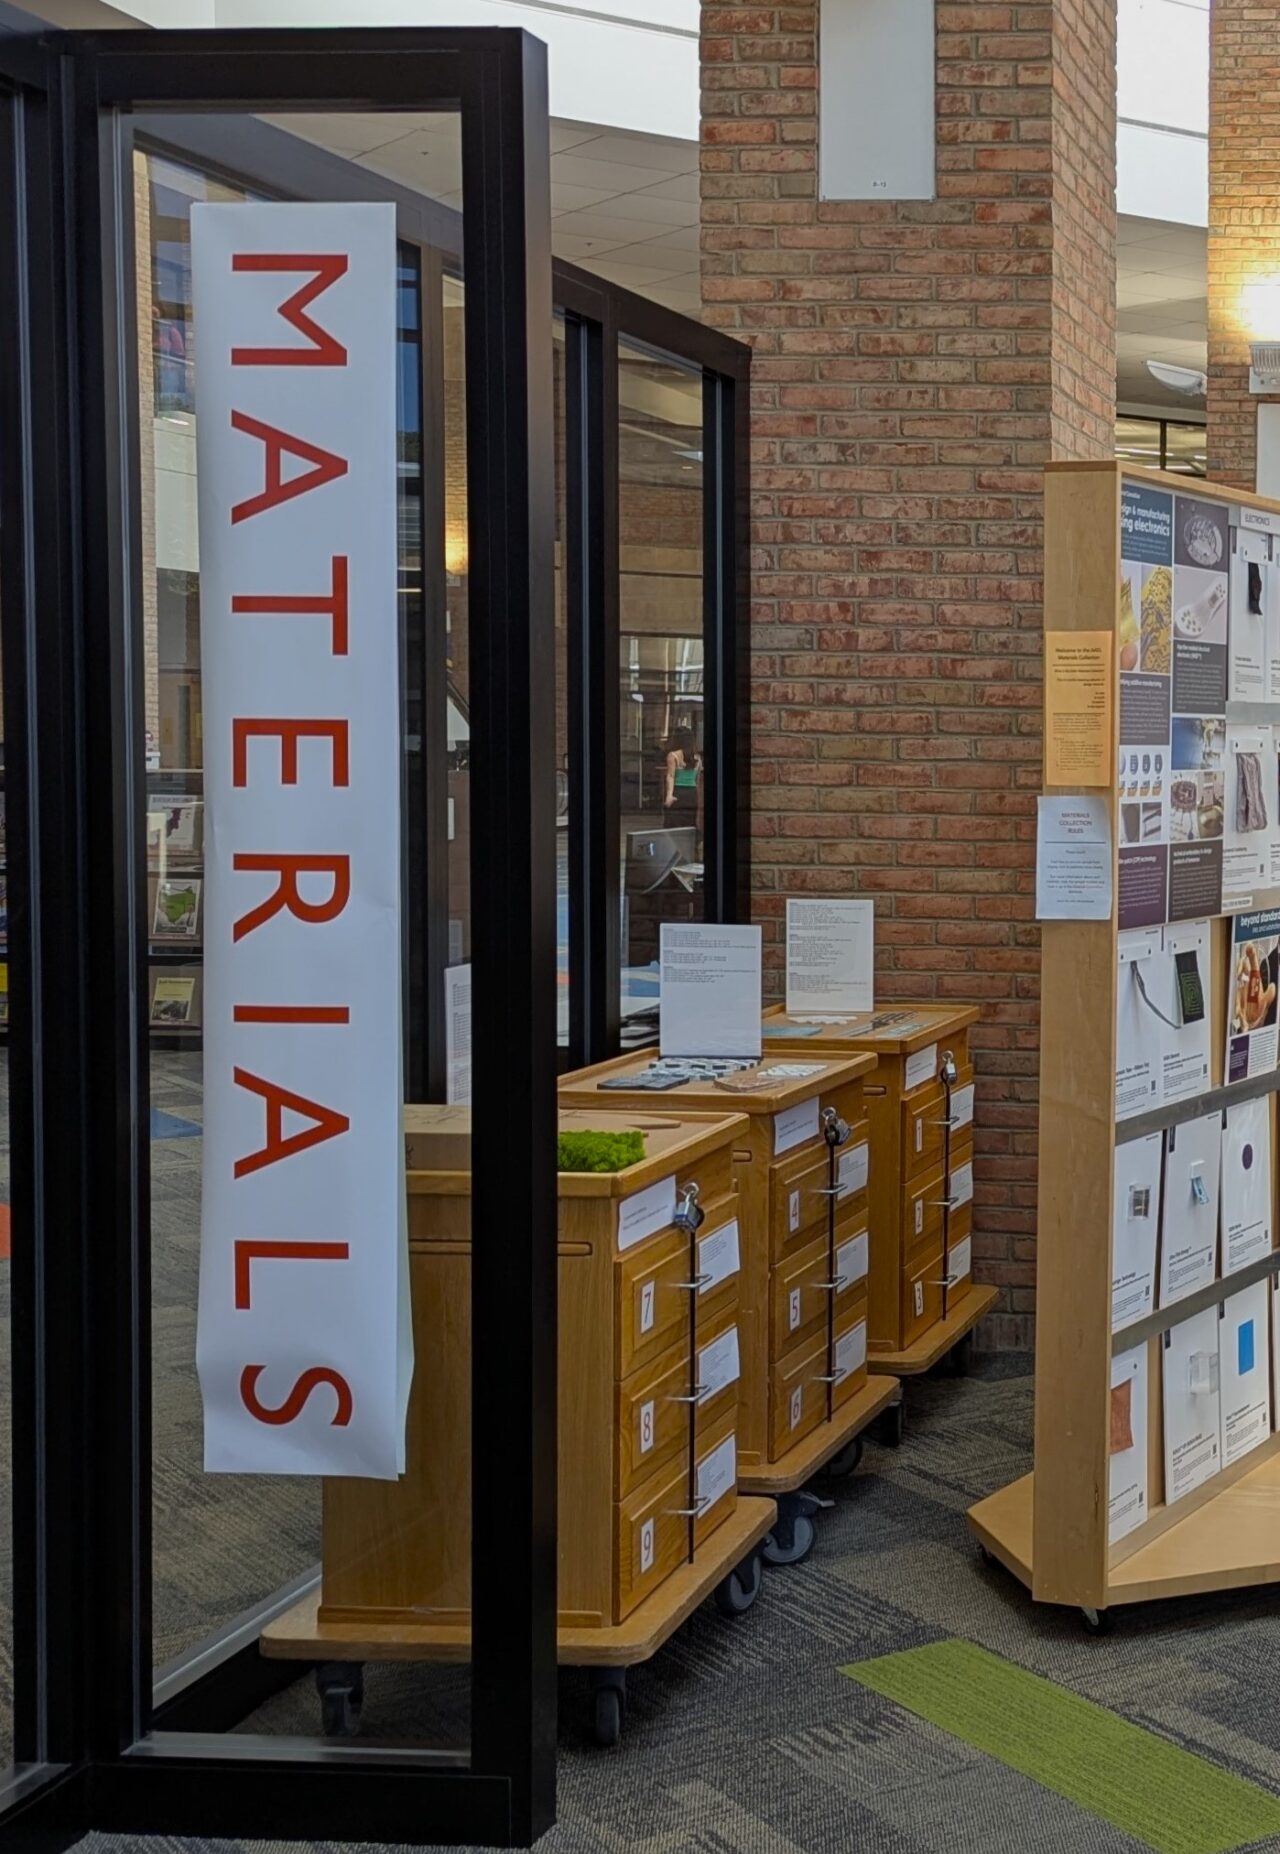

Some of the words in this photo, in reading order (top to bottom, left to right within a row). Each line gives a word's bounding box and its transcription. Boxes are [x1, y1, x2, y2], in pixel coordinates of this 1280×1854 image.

[1134, 517, 1170, 536] electronics
[231, 253, 353, 1428] MATERIALS
[1240, 912, 1260, 929] beyond
[791, 1198, 798, 1219] 4
[916, 1206, 922, 1228] 2
[644, 1291, 652, 1324] 7
[791, 1296, 798, 1322] 5
[916, 1287, 922, 1310] 3
[792, 1395, 799, 1419] 6
[643, 1411, 651, 1442] 8
[644, 1530, 651, 1561] 9
